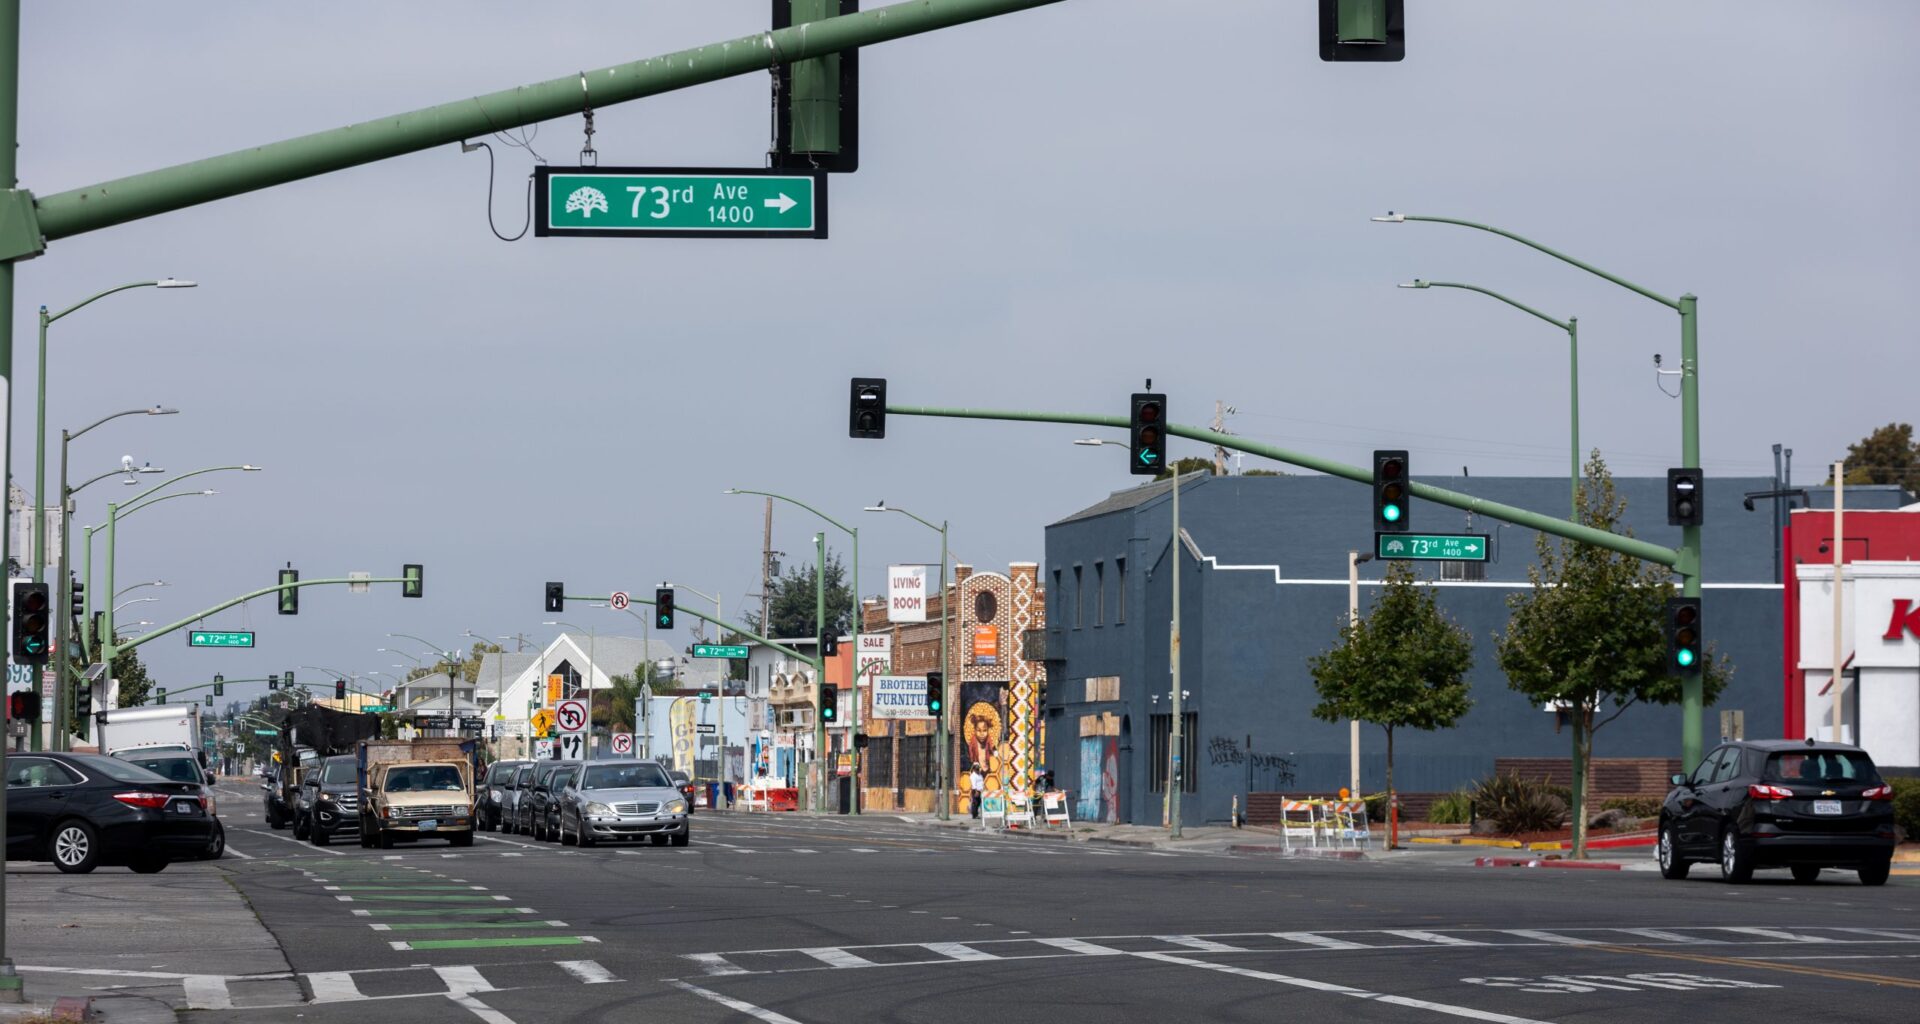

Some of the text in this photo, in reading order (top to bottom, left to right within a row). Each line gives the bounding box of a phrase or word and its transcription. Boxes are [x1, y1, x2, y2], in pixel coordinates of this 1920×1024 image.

[625, 182, 748, 219] 73rd Ave
[707, 205, 754, 224] 1400
[1410, 539, 1460, 554] 73rd Ave
[1442, 548, 1462, 557] 1400
[893, 577, 921, 589] LIVING
[893, 597, 921, 610] ROOM
[863, 637, 885, 648] SALE
[880, 679, 927, 690] BROTHER
[876, 693, 929, 706] FURNITU
